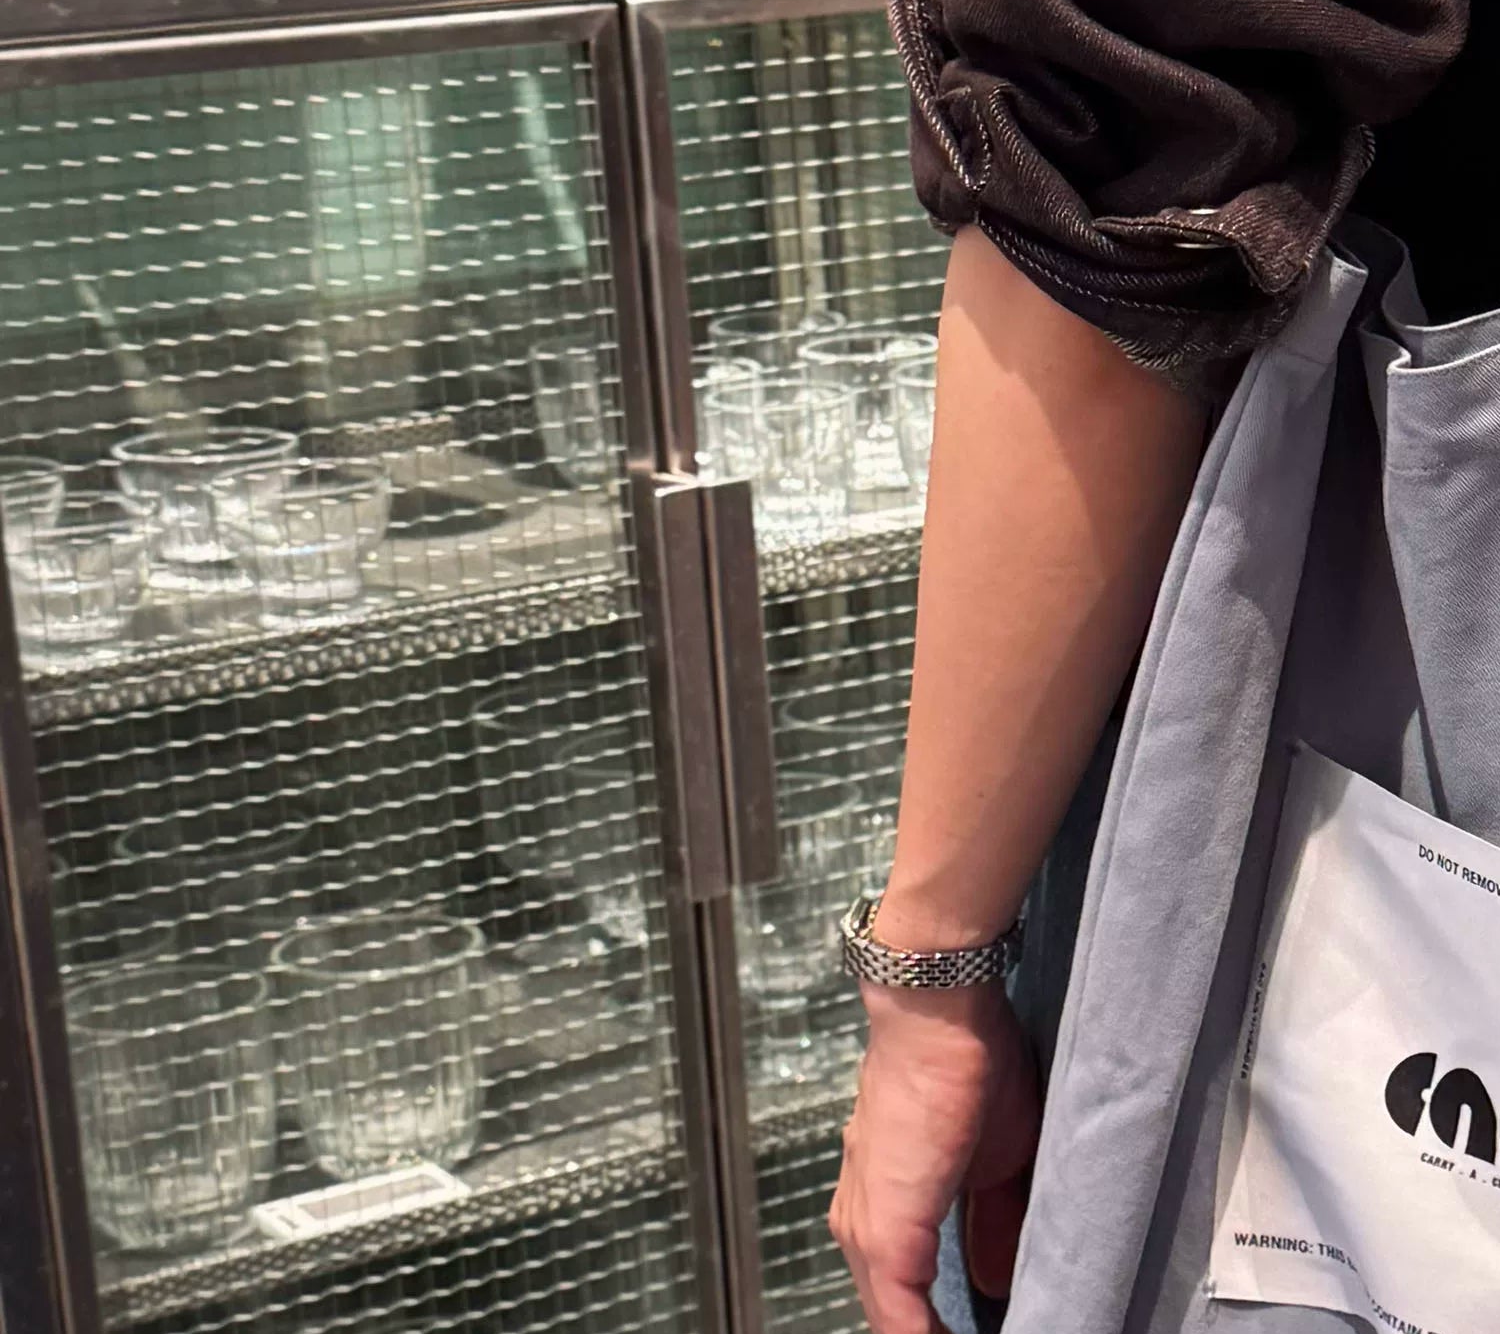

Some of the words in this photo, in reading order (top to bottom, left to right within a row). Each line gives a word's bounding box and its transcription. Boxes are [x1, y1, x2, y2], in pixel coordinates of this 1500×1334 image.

[1418, 843, 1435, 863] DO
[1436, 853, 1460, 875] NOT
[1420, 1152, 1455, 1172] CARRY
[1469, 1168, 1477, 1180] A
[1234, 1232, 1314, 1255] WARNING:
[1317, 1243, 1346, 1264] THIS
